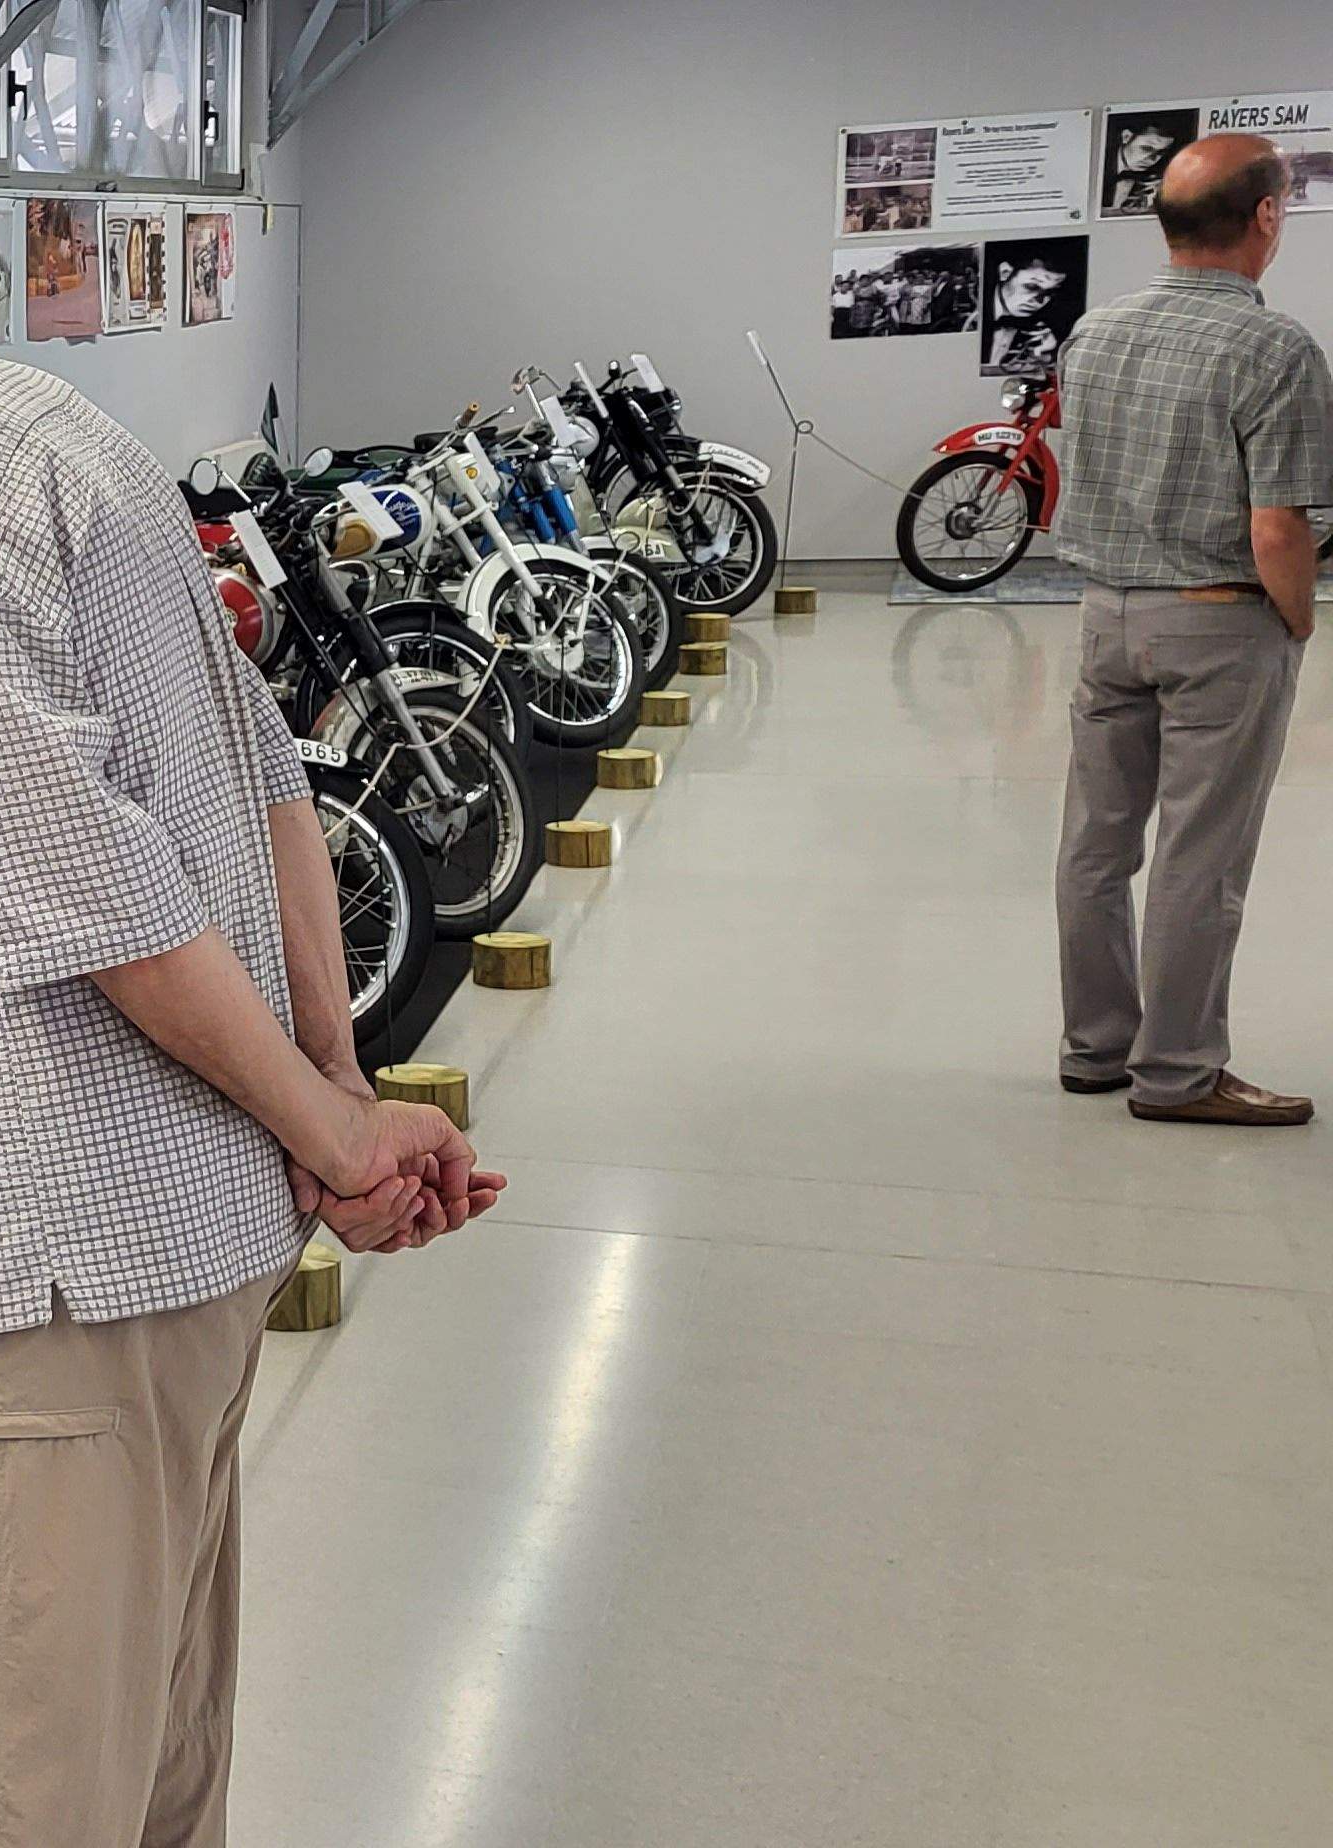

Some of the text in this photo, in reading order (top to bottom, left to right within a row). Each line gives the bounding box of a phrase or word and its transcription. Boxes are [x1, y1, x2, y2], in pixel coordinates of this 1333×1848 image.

[1209, 105, 1309, 129] RAYERS SAM
[301, 742, 341, 762] 665
